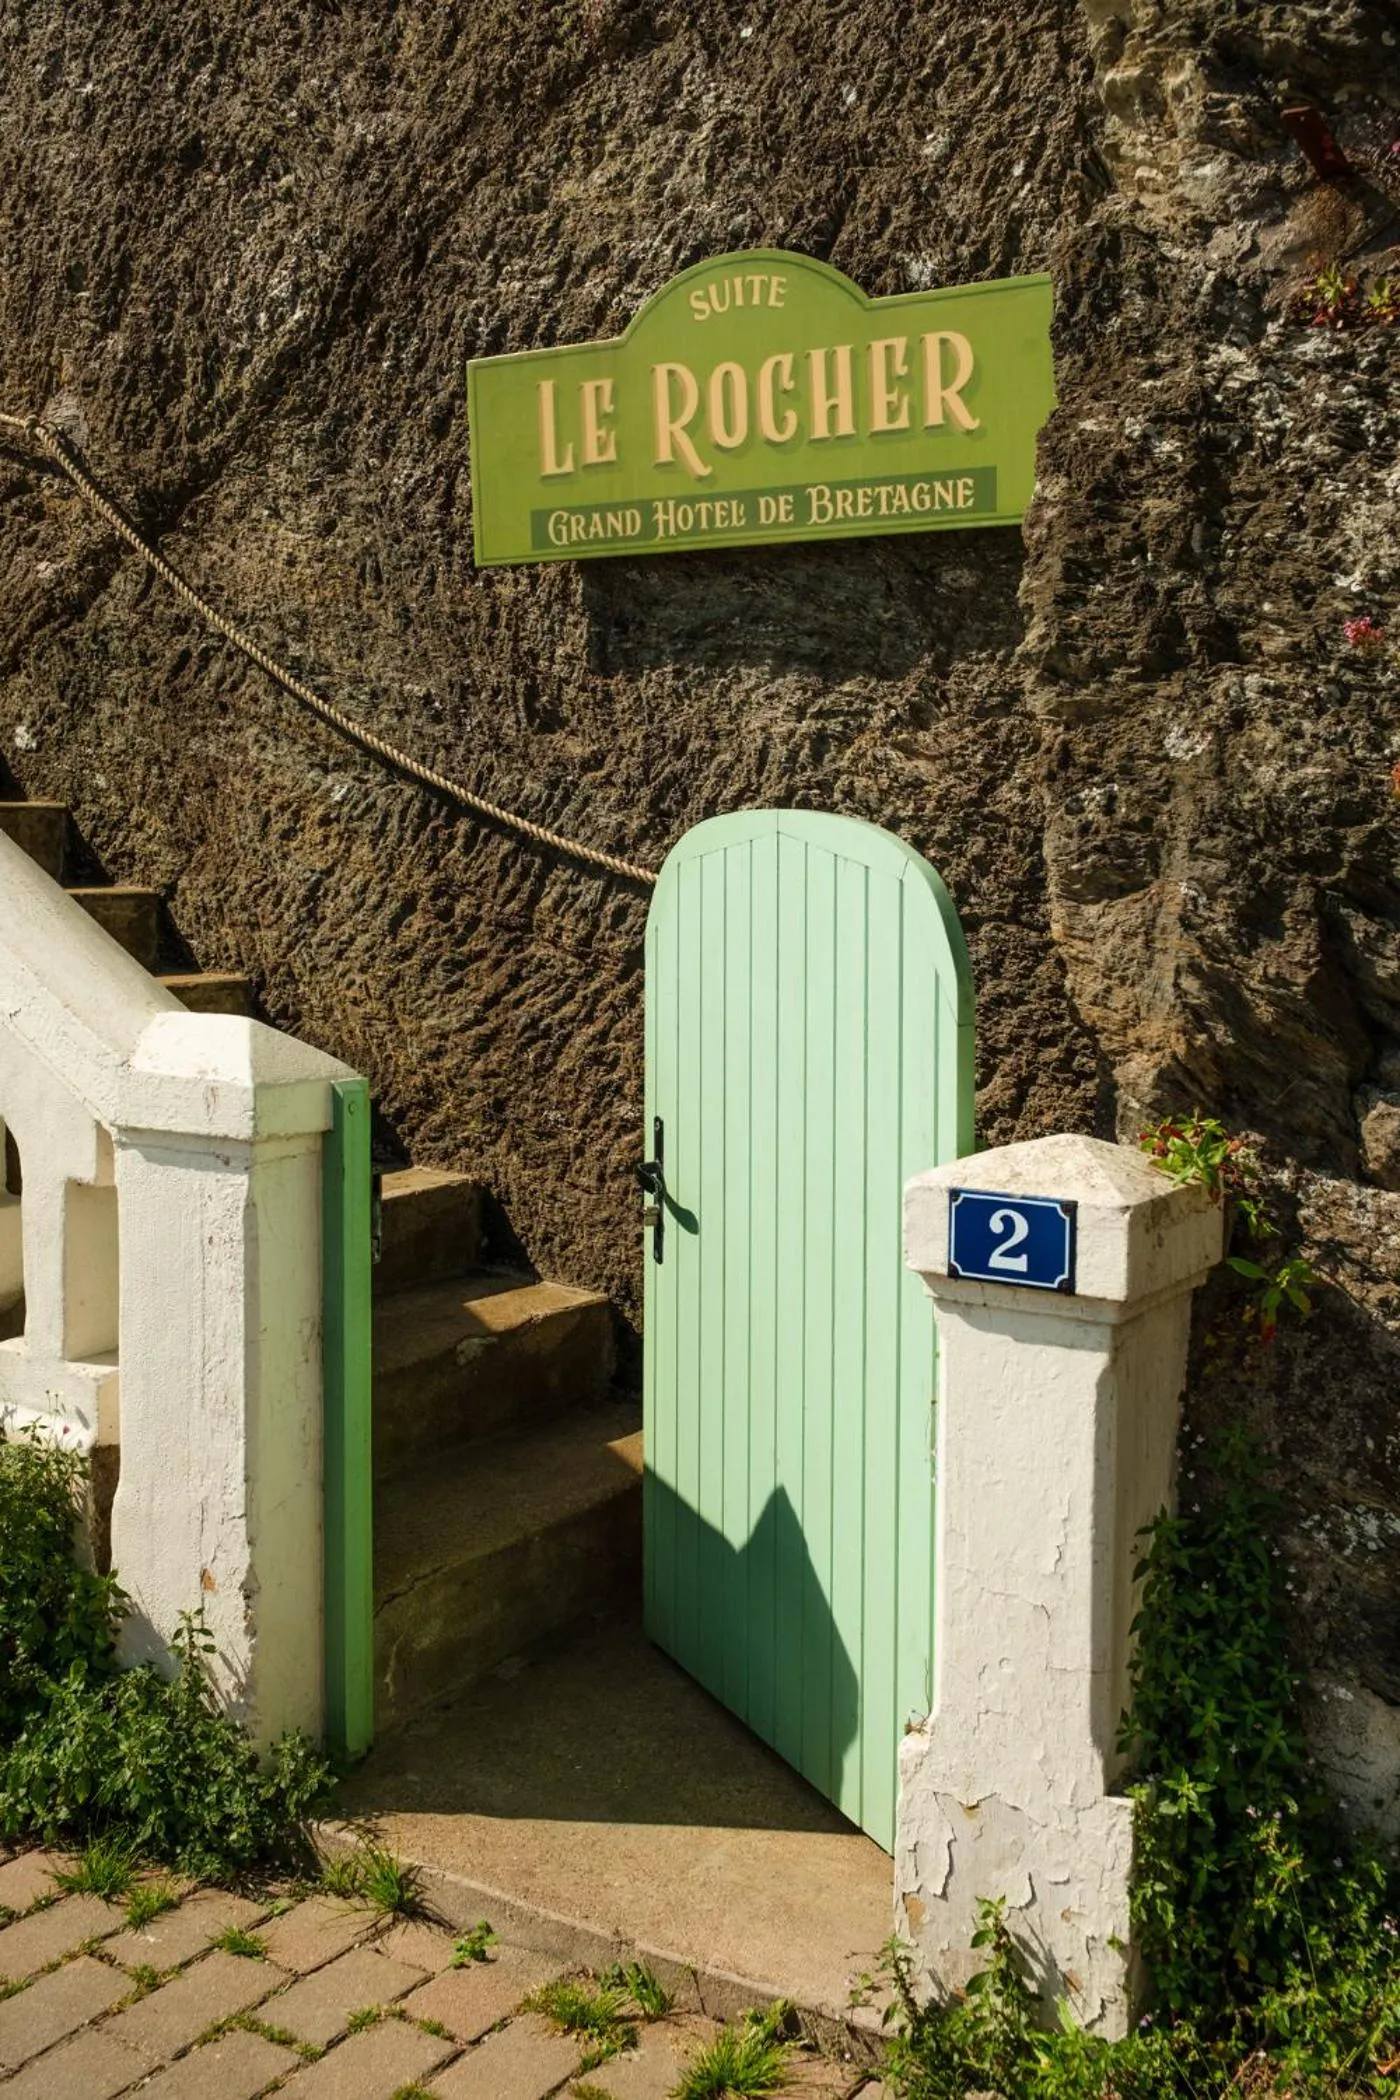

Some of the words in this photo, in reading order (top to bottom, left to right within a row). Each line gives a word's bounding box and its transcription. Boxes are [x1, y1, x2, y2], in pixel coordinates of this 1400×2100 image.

[690, 275, 787, 320] SUITE
[537, 378, 617, 477] LE
[651, 330, 980, 477] ROCHER
[548, 511, 641, 546] GRAND
[652, 500, 746, 540] HOTEL
[759, 494, 795, 525] DE
[805, 477, 975, 525] BRETAGNE
[987, 1209, 1029, 1272] 2
